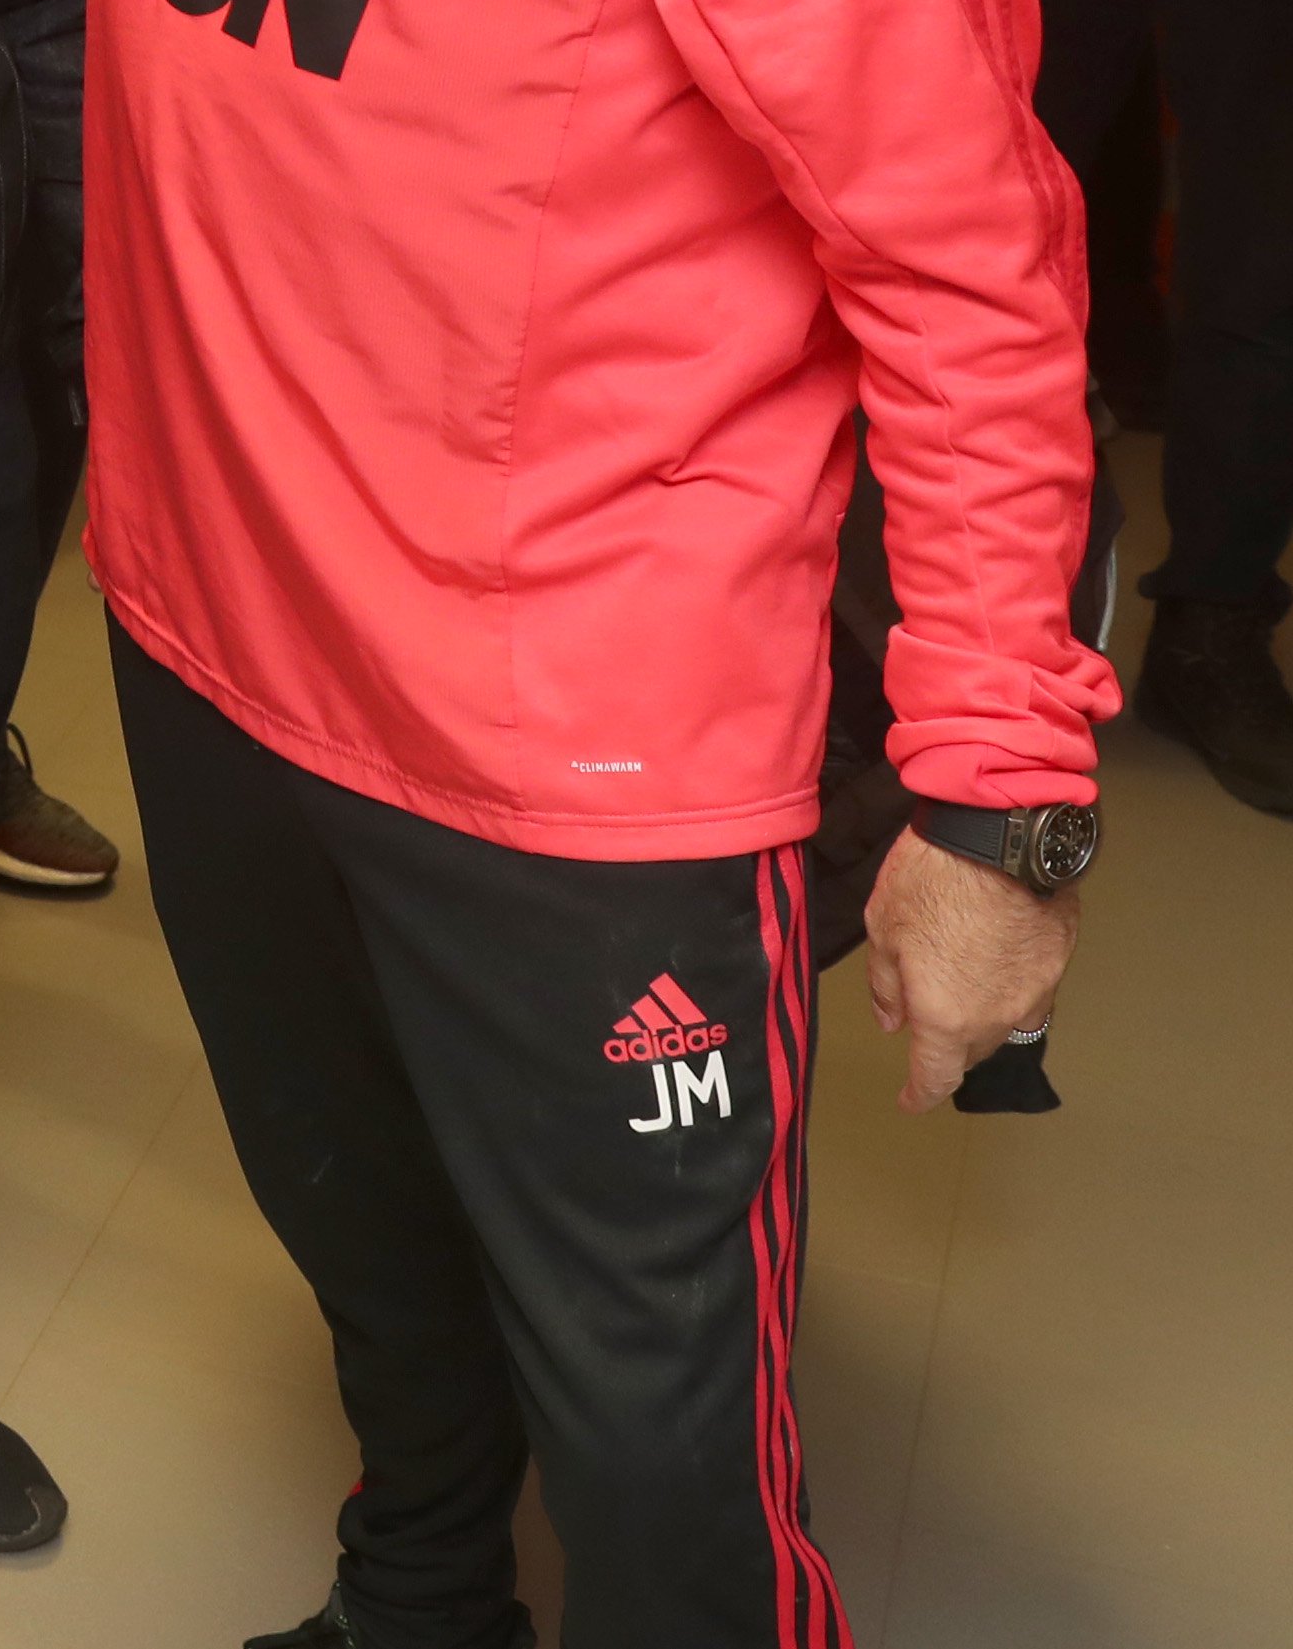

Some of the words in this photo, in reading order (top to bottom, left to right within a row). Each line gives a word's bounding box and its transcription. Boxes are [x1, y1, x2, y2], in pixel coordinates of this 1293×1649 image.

[579, 761, 642, 773] CLIMAWARM
[603, 1023, 729, 1063] adidas
[628, 1050, 732, 1133] JM
